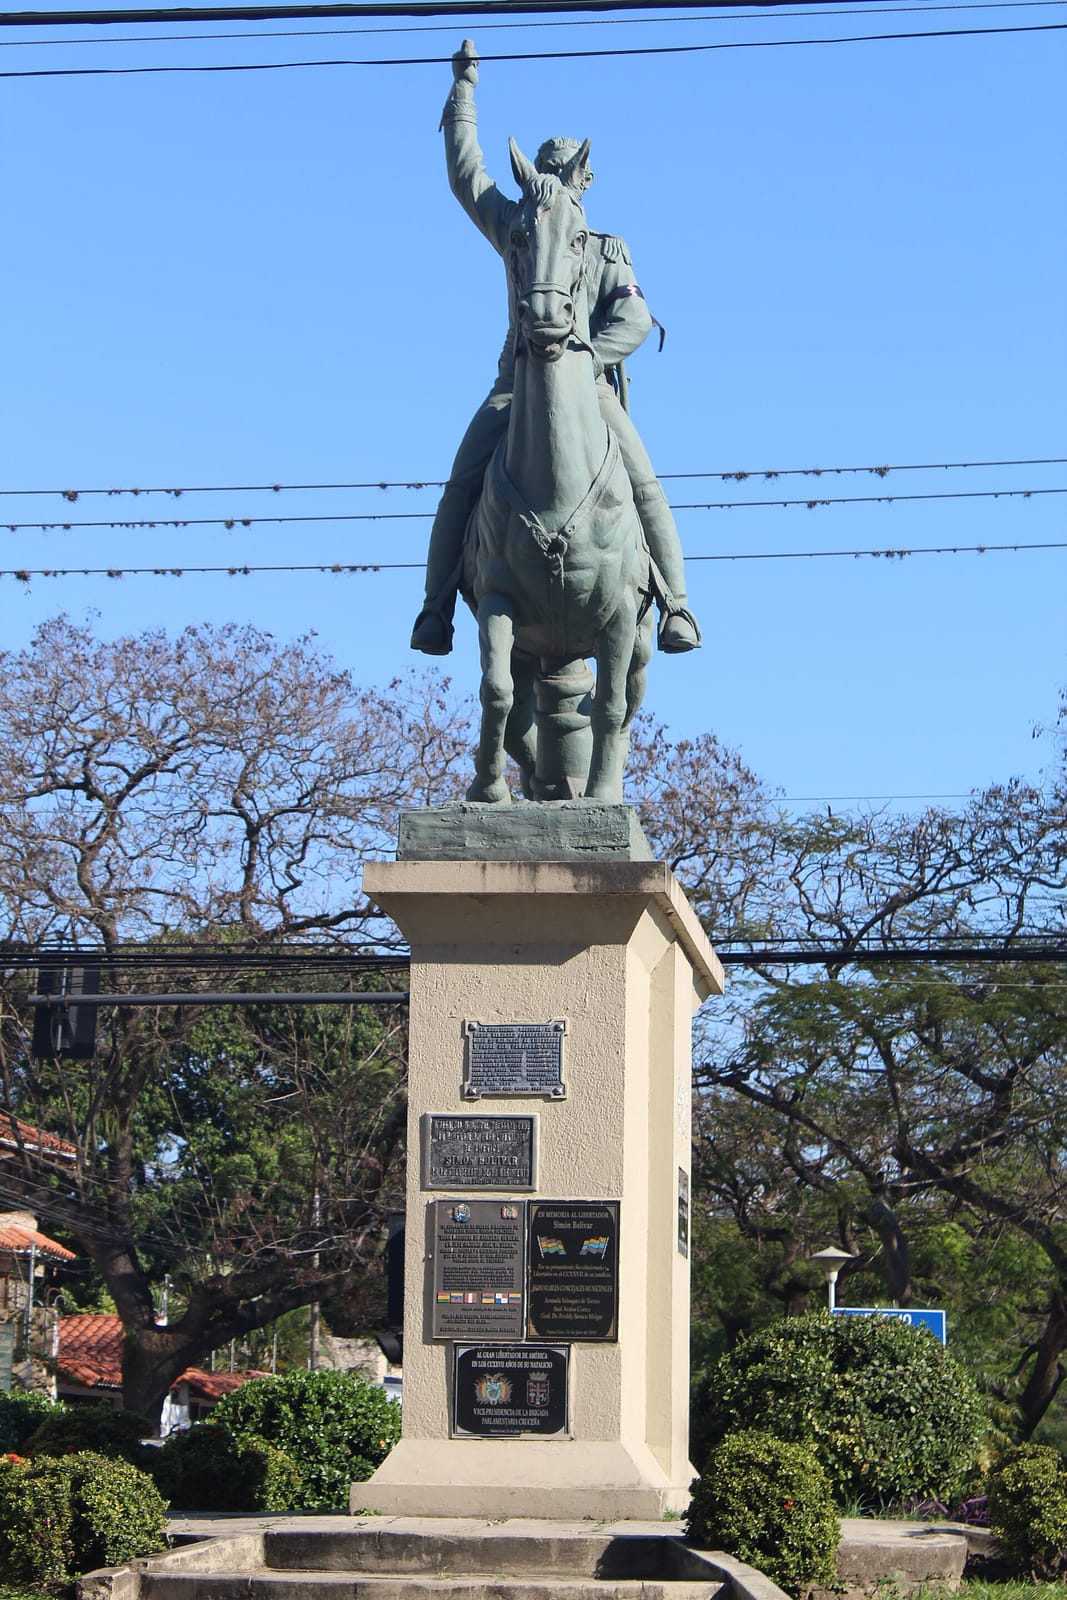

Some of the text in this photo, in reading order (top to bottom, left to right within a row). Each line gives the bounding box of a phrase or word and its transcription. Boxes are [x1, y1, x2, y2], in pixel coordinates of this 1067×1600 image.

[479, 1155, 518, 1166] BOLIVAR
[546, 1211, 570, 1219] MEMORIA
[579, 1211, 609, 1219] LIBERTADOR
[477, 1351, 482, 1359] AL
[483, 1351, 495, 1359] GRAN
[496, 1351, 521, 1359] LIBERTADOR
[472, 1360, 478, 1368] EN
[478, 1360, 486, 1368] LOS
[505, 1360, 517, 1368] AÑOS
[530, 1361, 553, 1369] NATALICIO
[515, 1408, 522, 1417] DE
[482, 1417, 540, 1425] PARLAMENTARIA CRUCEÑA
